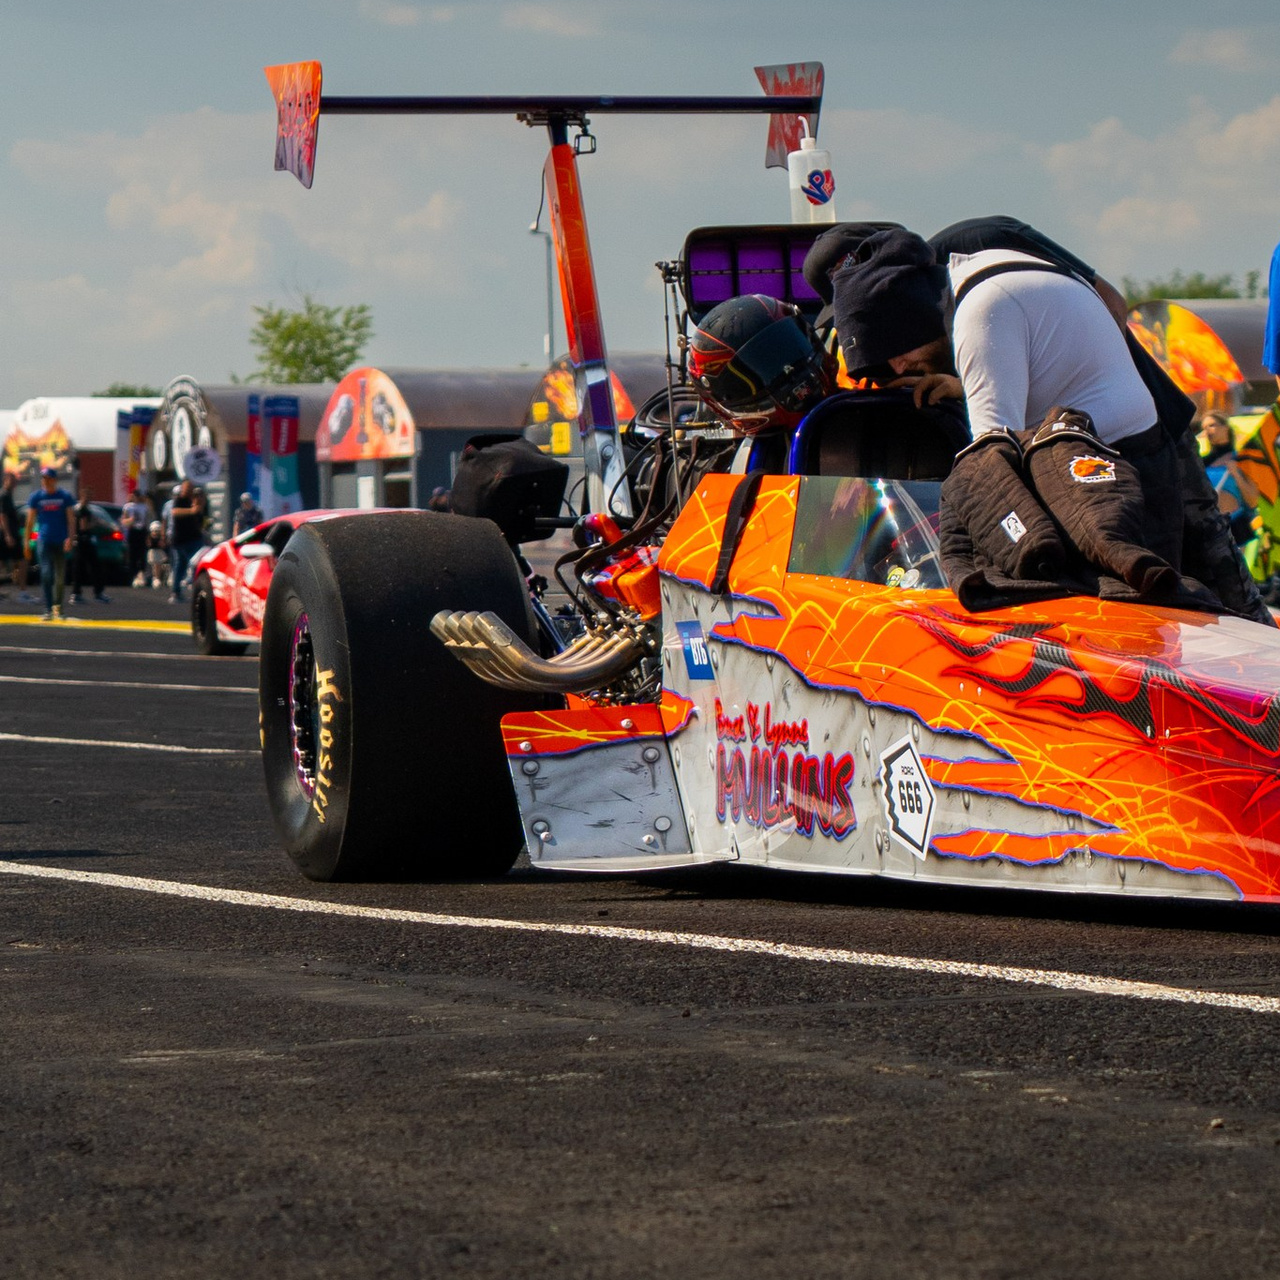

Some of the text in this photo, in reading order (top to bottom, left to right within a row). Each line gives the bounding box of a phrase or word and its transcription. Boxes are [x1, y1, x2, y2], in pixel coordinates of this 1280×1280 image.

[689, 637, 708, 666] ВТБ
[313, 662, 343, 824] Hoosier
[716, 742, 857, 842] MULLINS
[898, 780, 923, 815] 666
